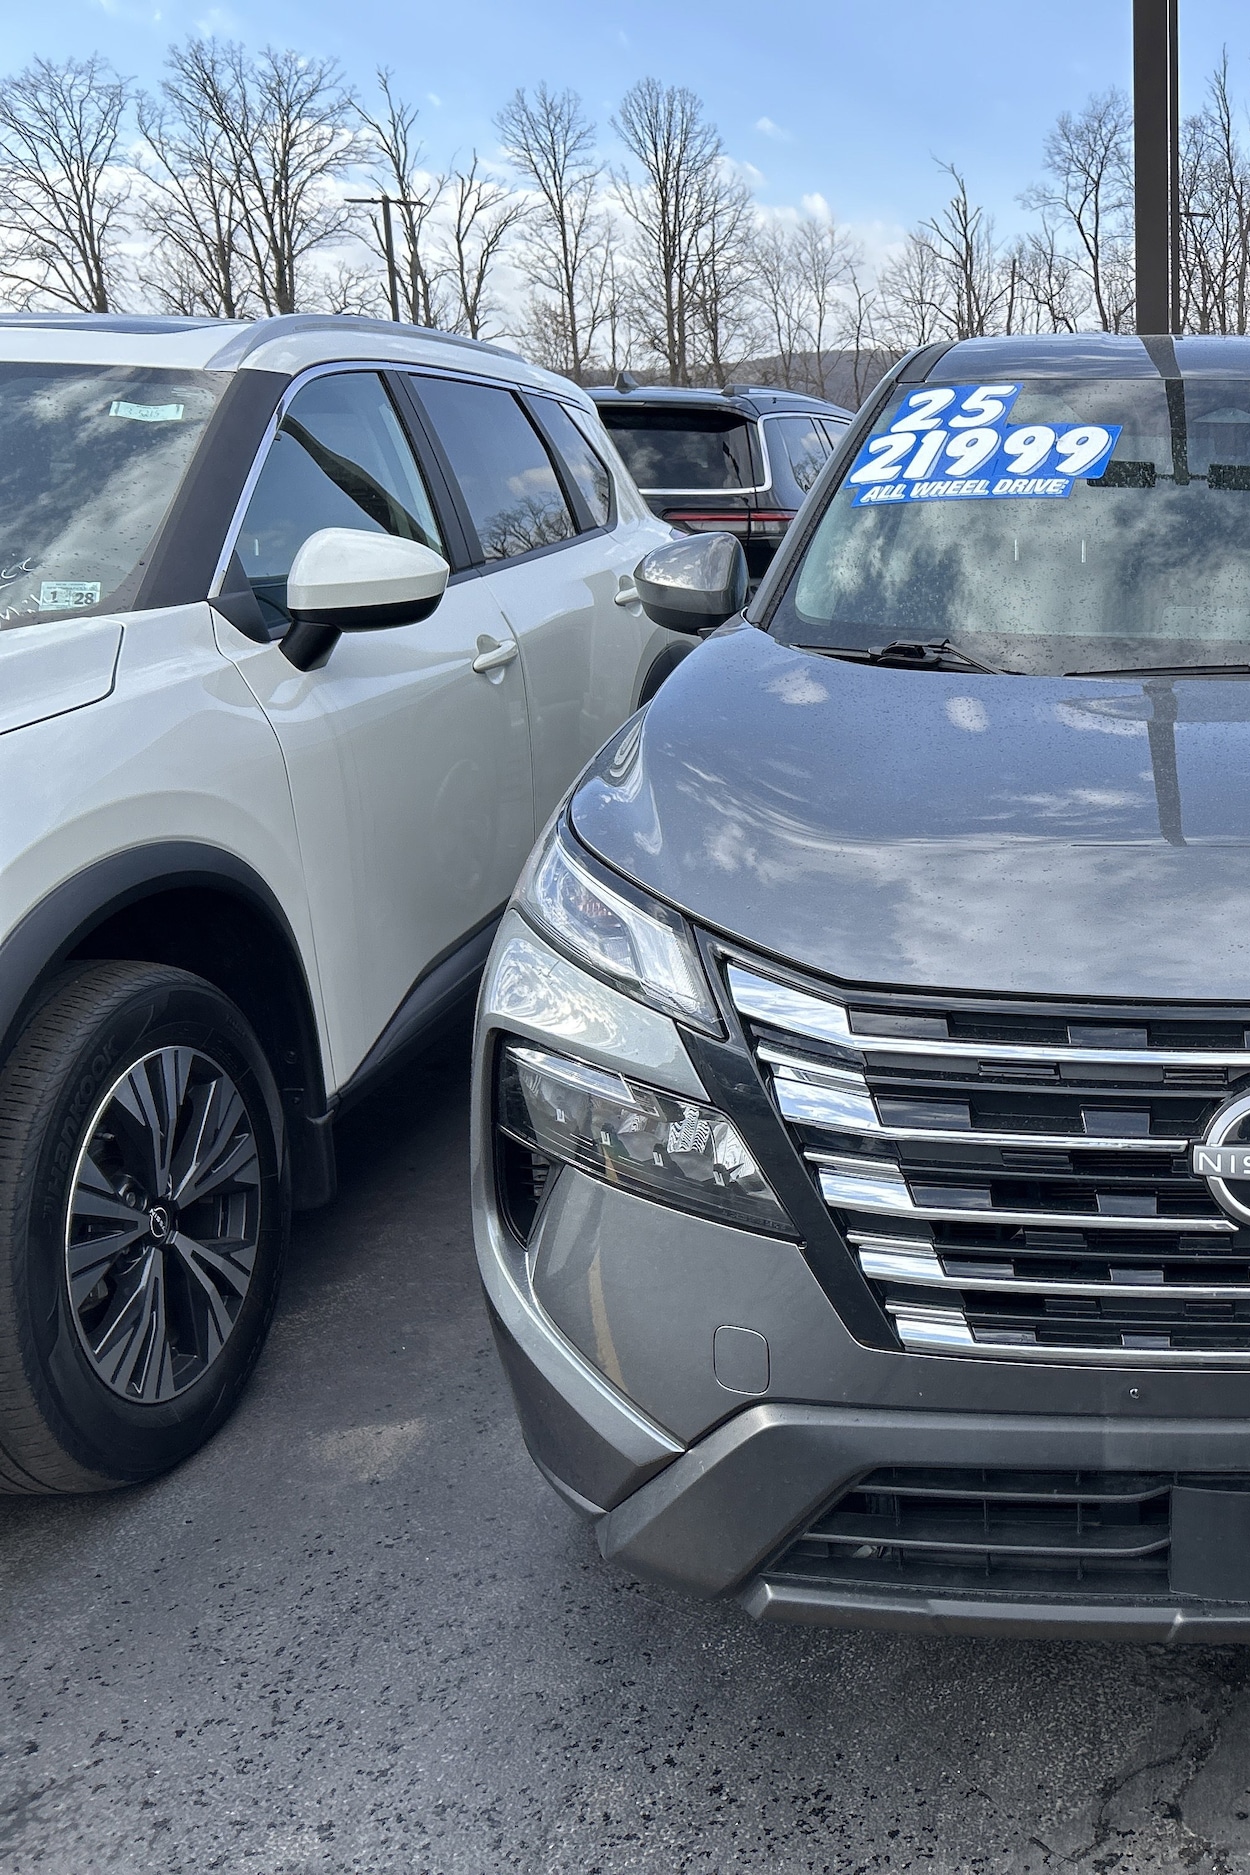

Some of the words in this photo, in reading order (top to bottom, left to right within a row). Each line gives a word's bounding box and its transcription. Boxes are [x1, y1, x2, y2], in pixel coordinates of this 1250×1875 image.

[891, 385, 1018, 433] 25
[850, 425, 1112, 484] 21999
[860, 484, 905, 503] ALL
[910, 480, 989, 498] WHEEL
[992, 478, 1069, 495] DRIVE
[73, 592, 95, 605] 28
